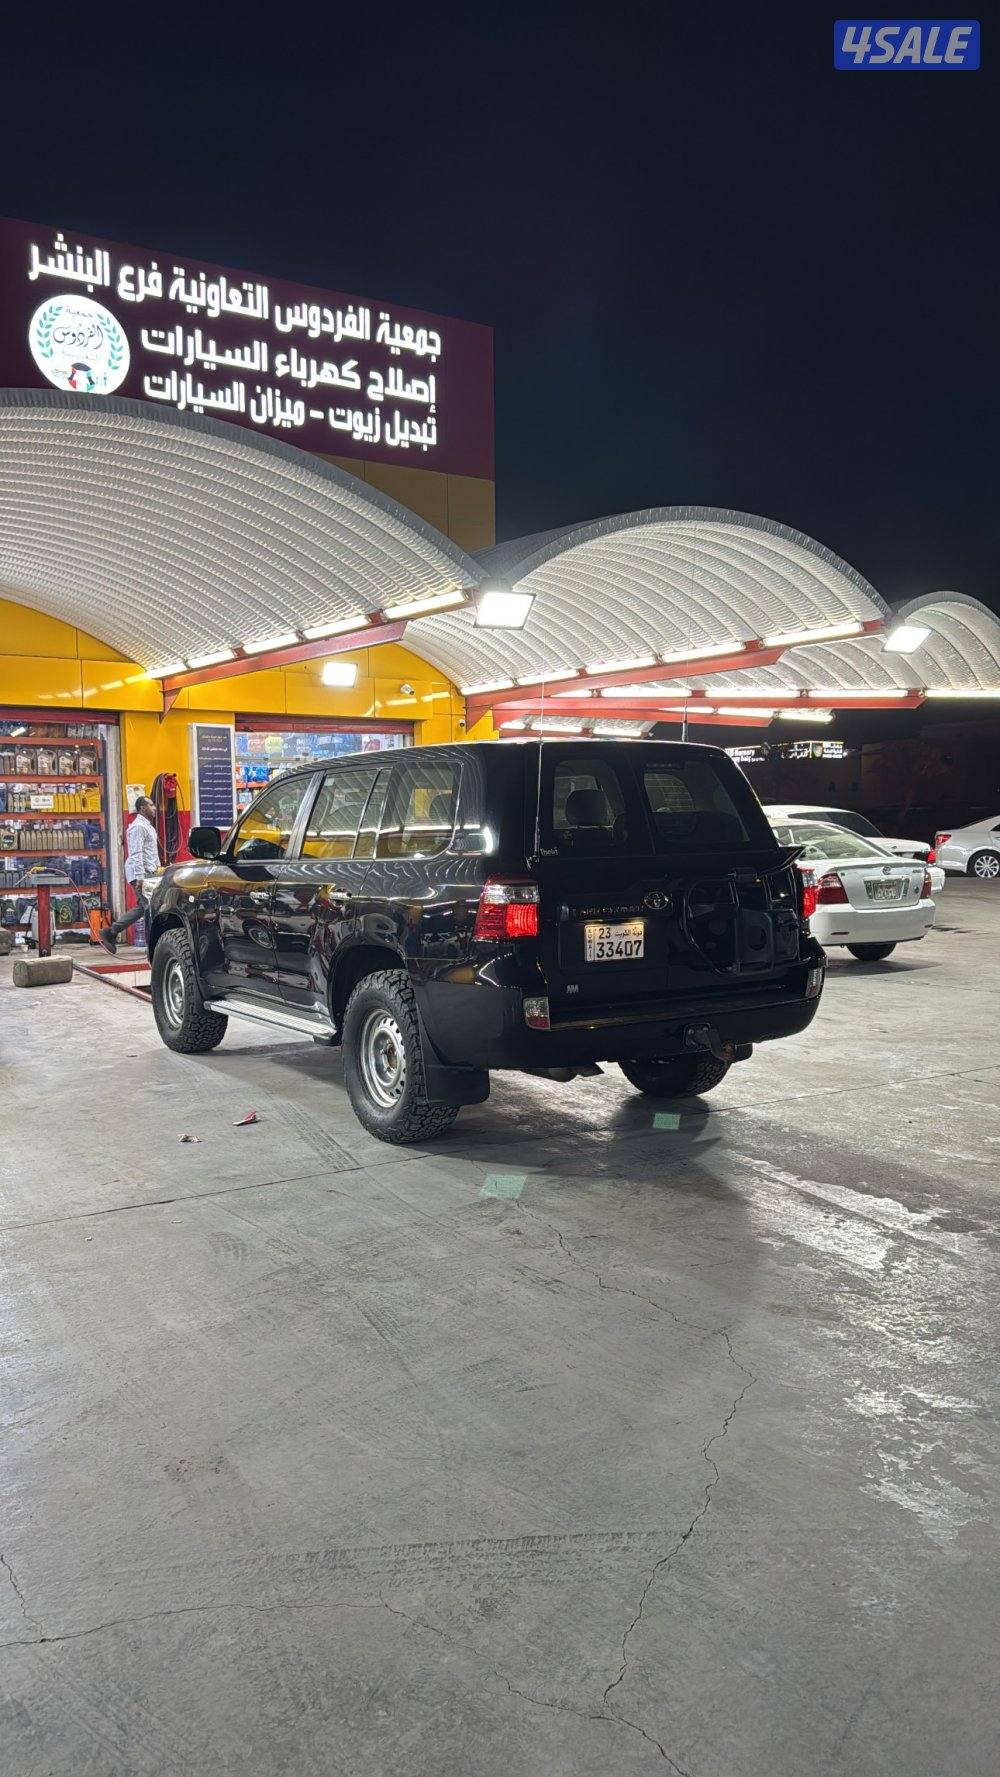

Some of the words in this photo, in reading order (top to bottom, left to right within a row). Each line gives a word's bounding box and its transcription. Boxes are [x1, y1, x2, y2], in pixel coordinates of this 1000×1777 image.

[28, 233, 110, 292] البنشر
[117, 262, 163, 302] فرع
[169, 266, 269, 319] التعاونية
[274, 302, 370, 342] الفردوس
[376, 312, 441, 362] جمعية
[141, 325, 268, 372] السيارات
[274, 347, 361, 390] كهرباء
[143, 371, 245, 414] السيارات
[250, 385, 305, 428] ميزان
[367, 366, 436, 413] إصلاح
[329, 406, 381, 443] زيوت
[385, 410, 437, 451] تبديل
[596, 940, 642, 958] 33407
[598, 927, 611, 939] 23
